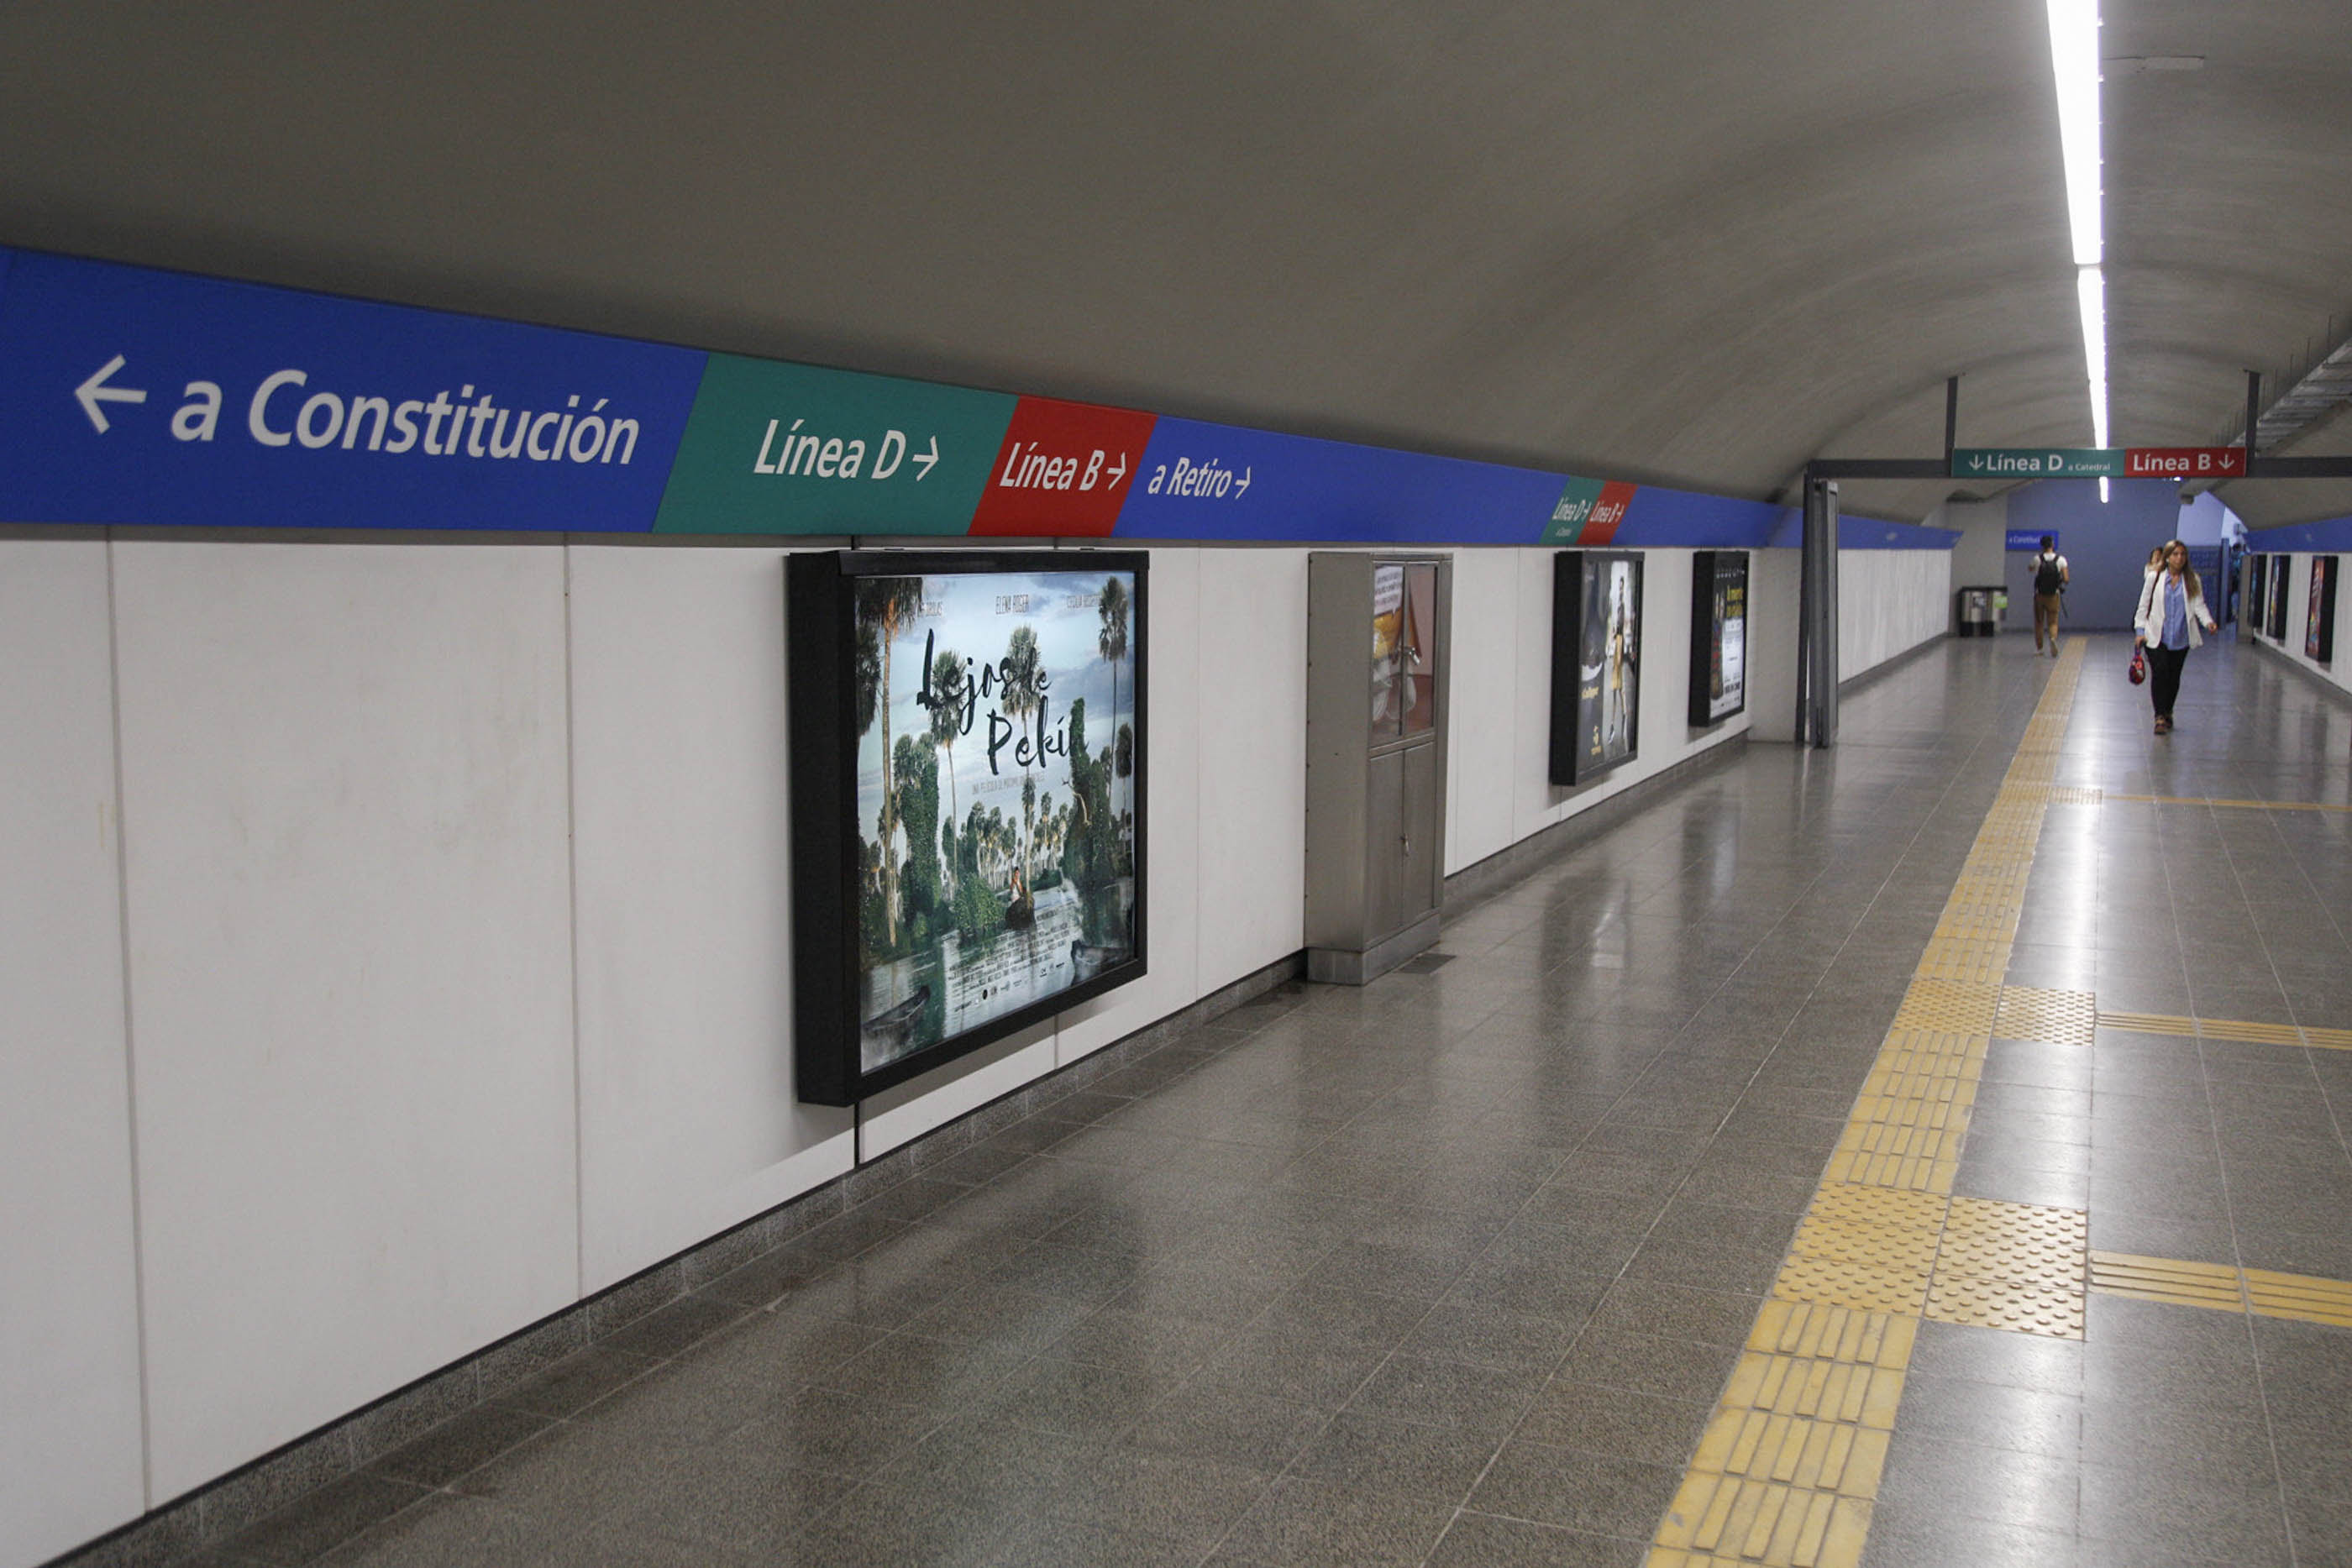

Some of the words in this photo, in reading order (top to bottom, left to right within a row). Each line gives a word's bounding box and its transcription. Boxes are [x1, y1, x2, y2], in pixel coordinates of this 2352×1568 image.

[171, 380, 223, 442] a
[248, 369, 640, 465] Constitución
[753, 418, 866, 480] Línea
[870, 429, 906, 480] D
[1987, 453, 2041, 472] Línea
[2048, 454, 2064, 472] D
[2075, 462, 2111, 472] Catedral
[2133, 454, 2190, 472] Línea
[2198, 454, 2212, 471] B
[999, 442, 1078, 491] Línea
[1078, 449, 1105, 492] B
[1147, 464, 1167, 496] a
[1166, 456, 1232, 499] Retiro
[1551, 496, 1578, 522] Línea
[1589, 501, 1613, 523] Línea
